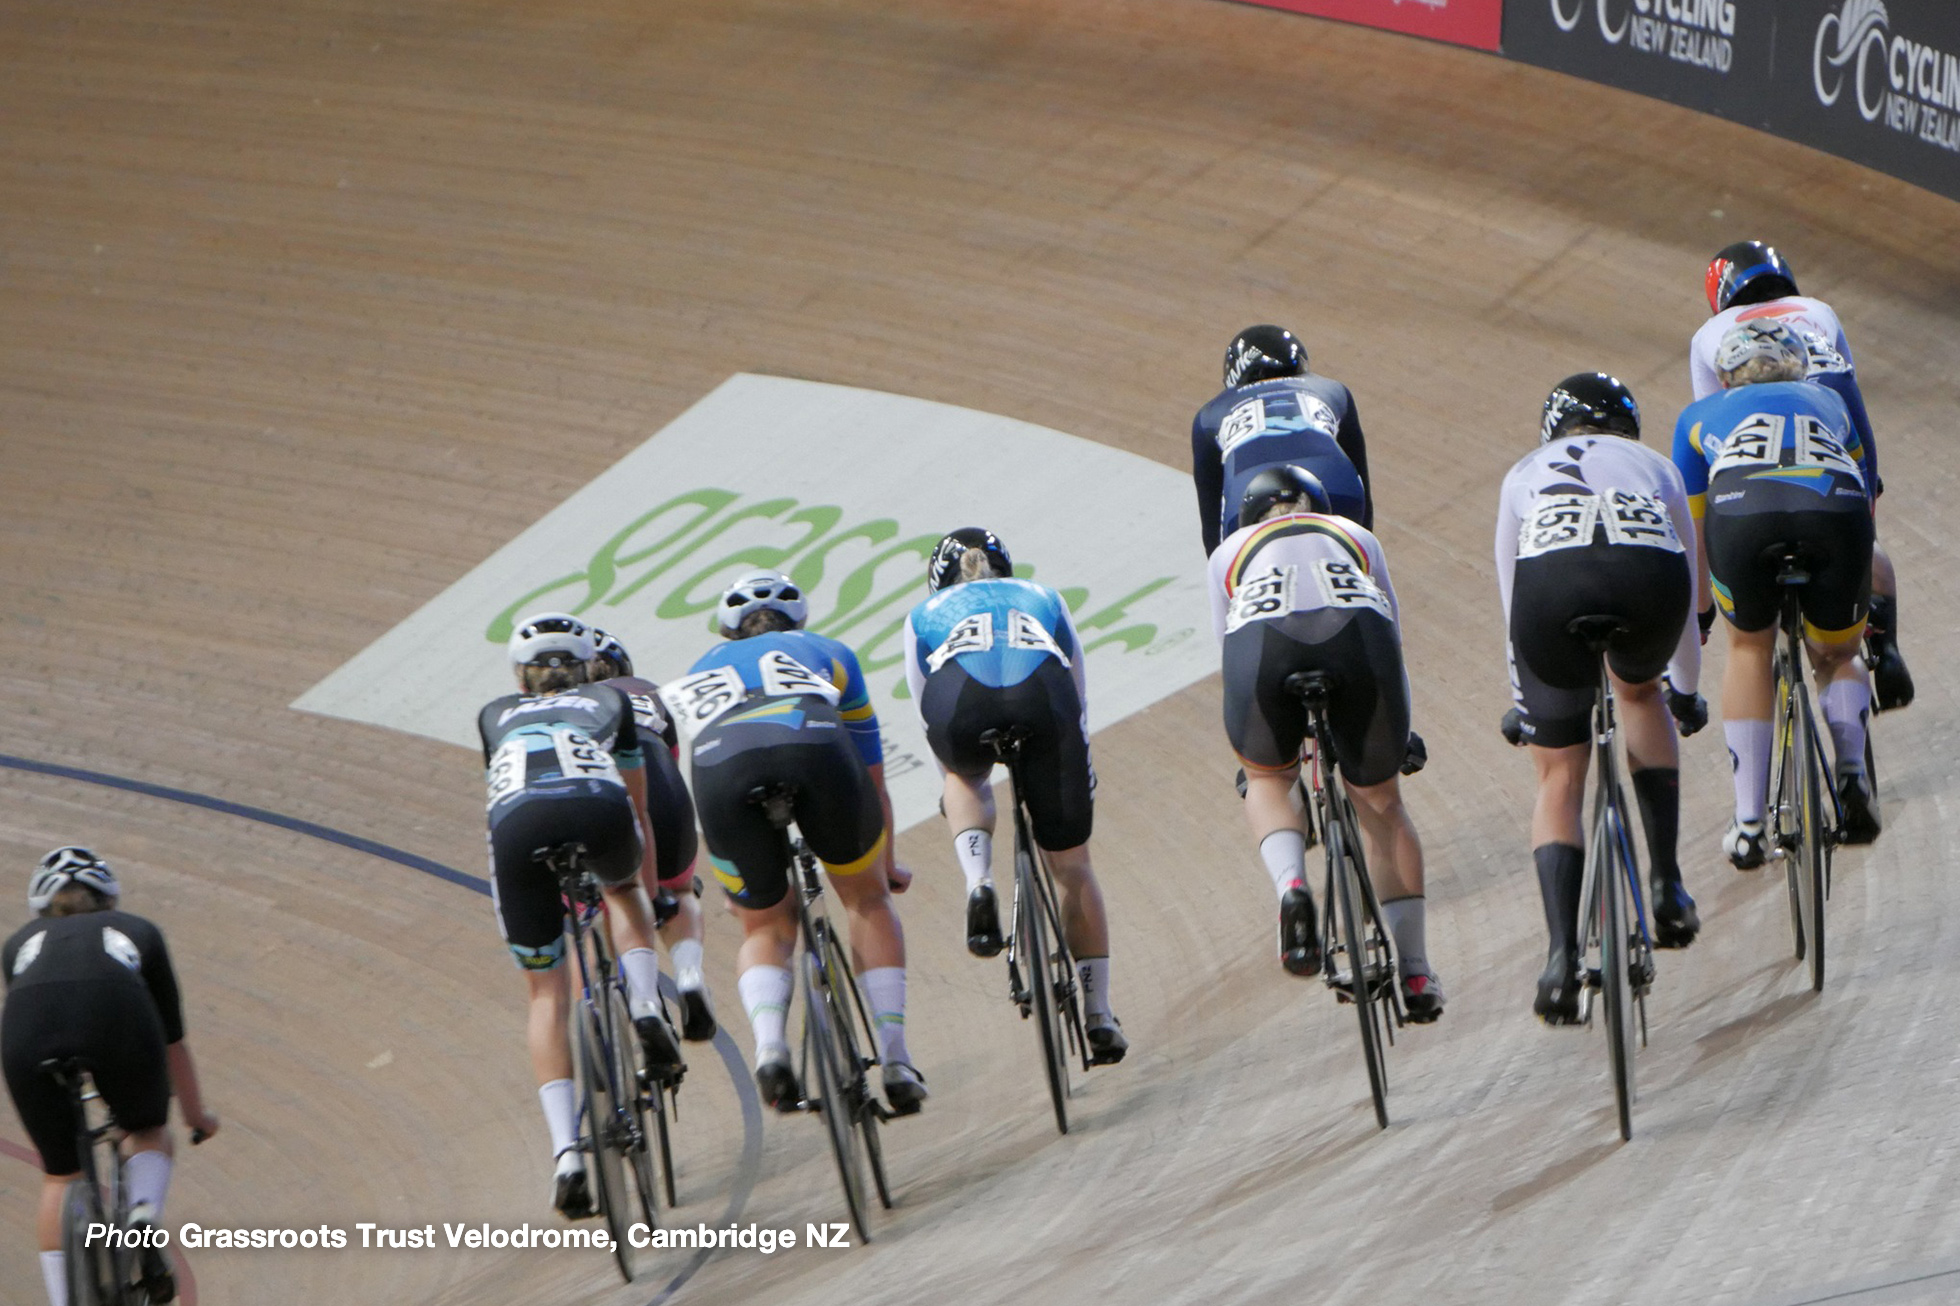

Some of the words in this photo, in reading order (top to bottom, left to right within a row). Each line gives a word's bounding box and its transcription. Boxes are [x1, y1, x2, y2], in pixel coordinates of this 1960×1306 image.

[1634, 0, 1736, 36] LING
[1630, 14, 1667, 54] NEW
[1669, 25, 1733, 73] ZEALAND
[1885, 92, 1919, 133] NEW
[1723, 418, 1770, 459] 147
[1808, 420, 1856, 466] 147
[1533, 498, 1584, 548] 153
[1614, 491, 1666, 538] 153
[486, 486, 1180, 699] grassro
[1240, 568, 1284, 618] 158
[1326, 562, 1379, 602] 158
[682, 673, 732, 720] 146
